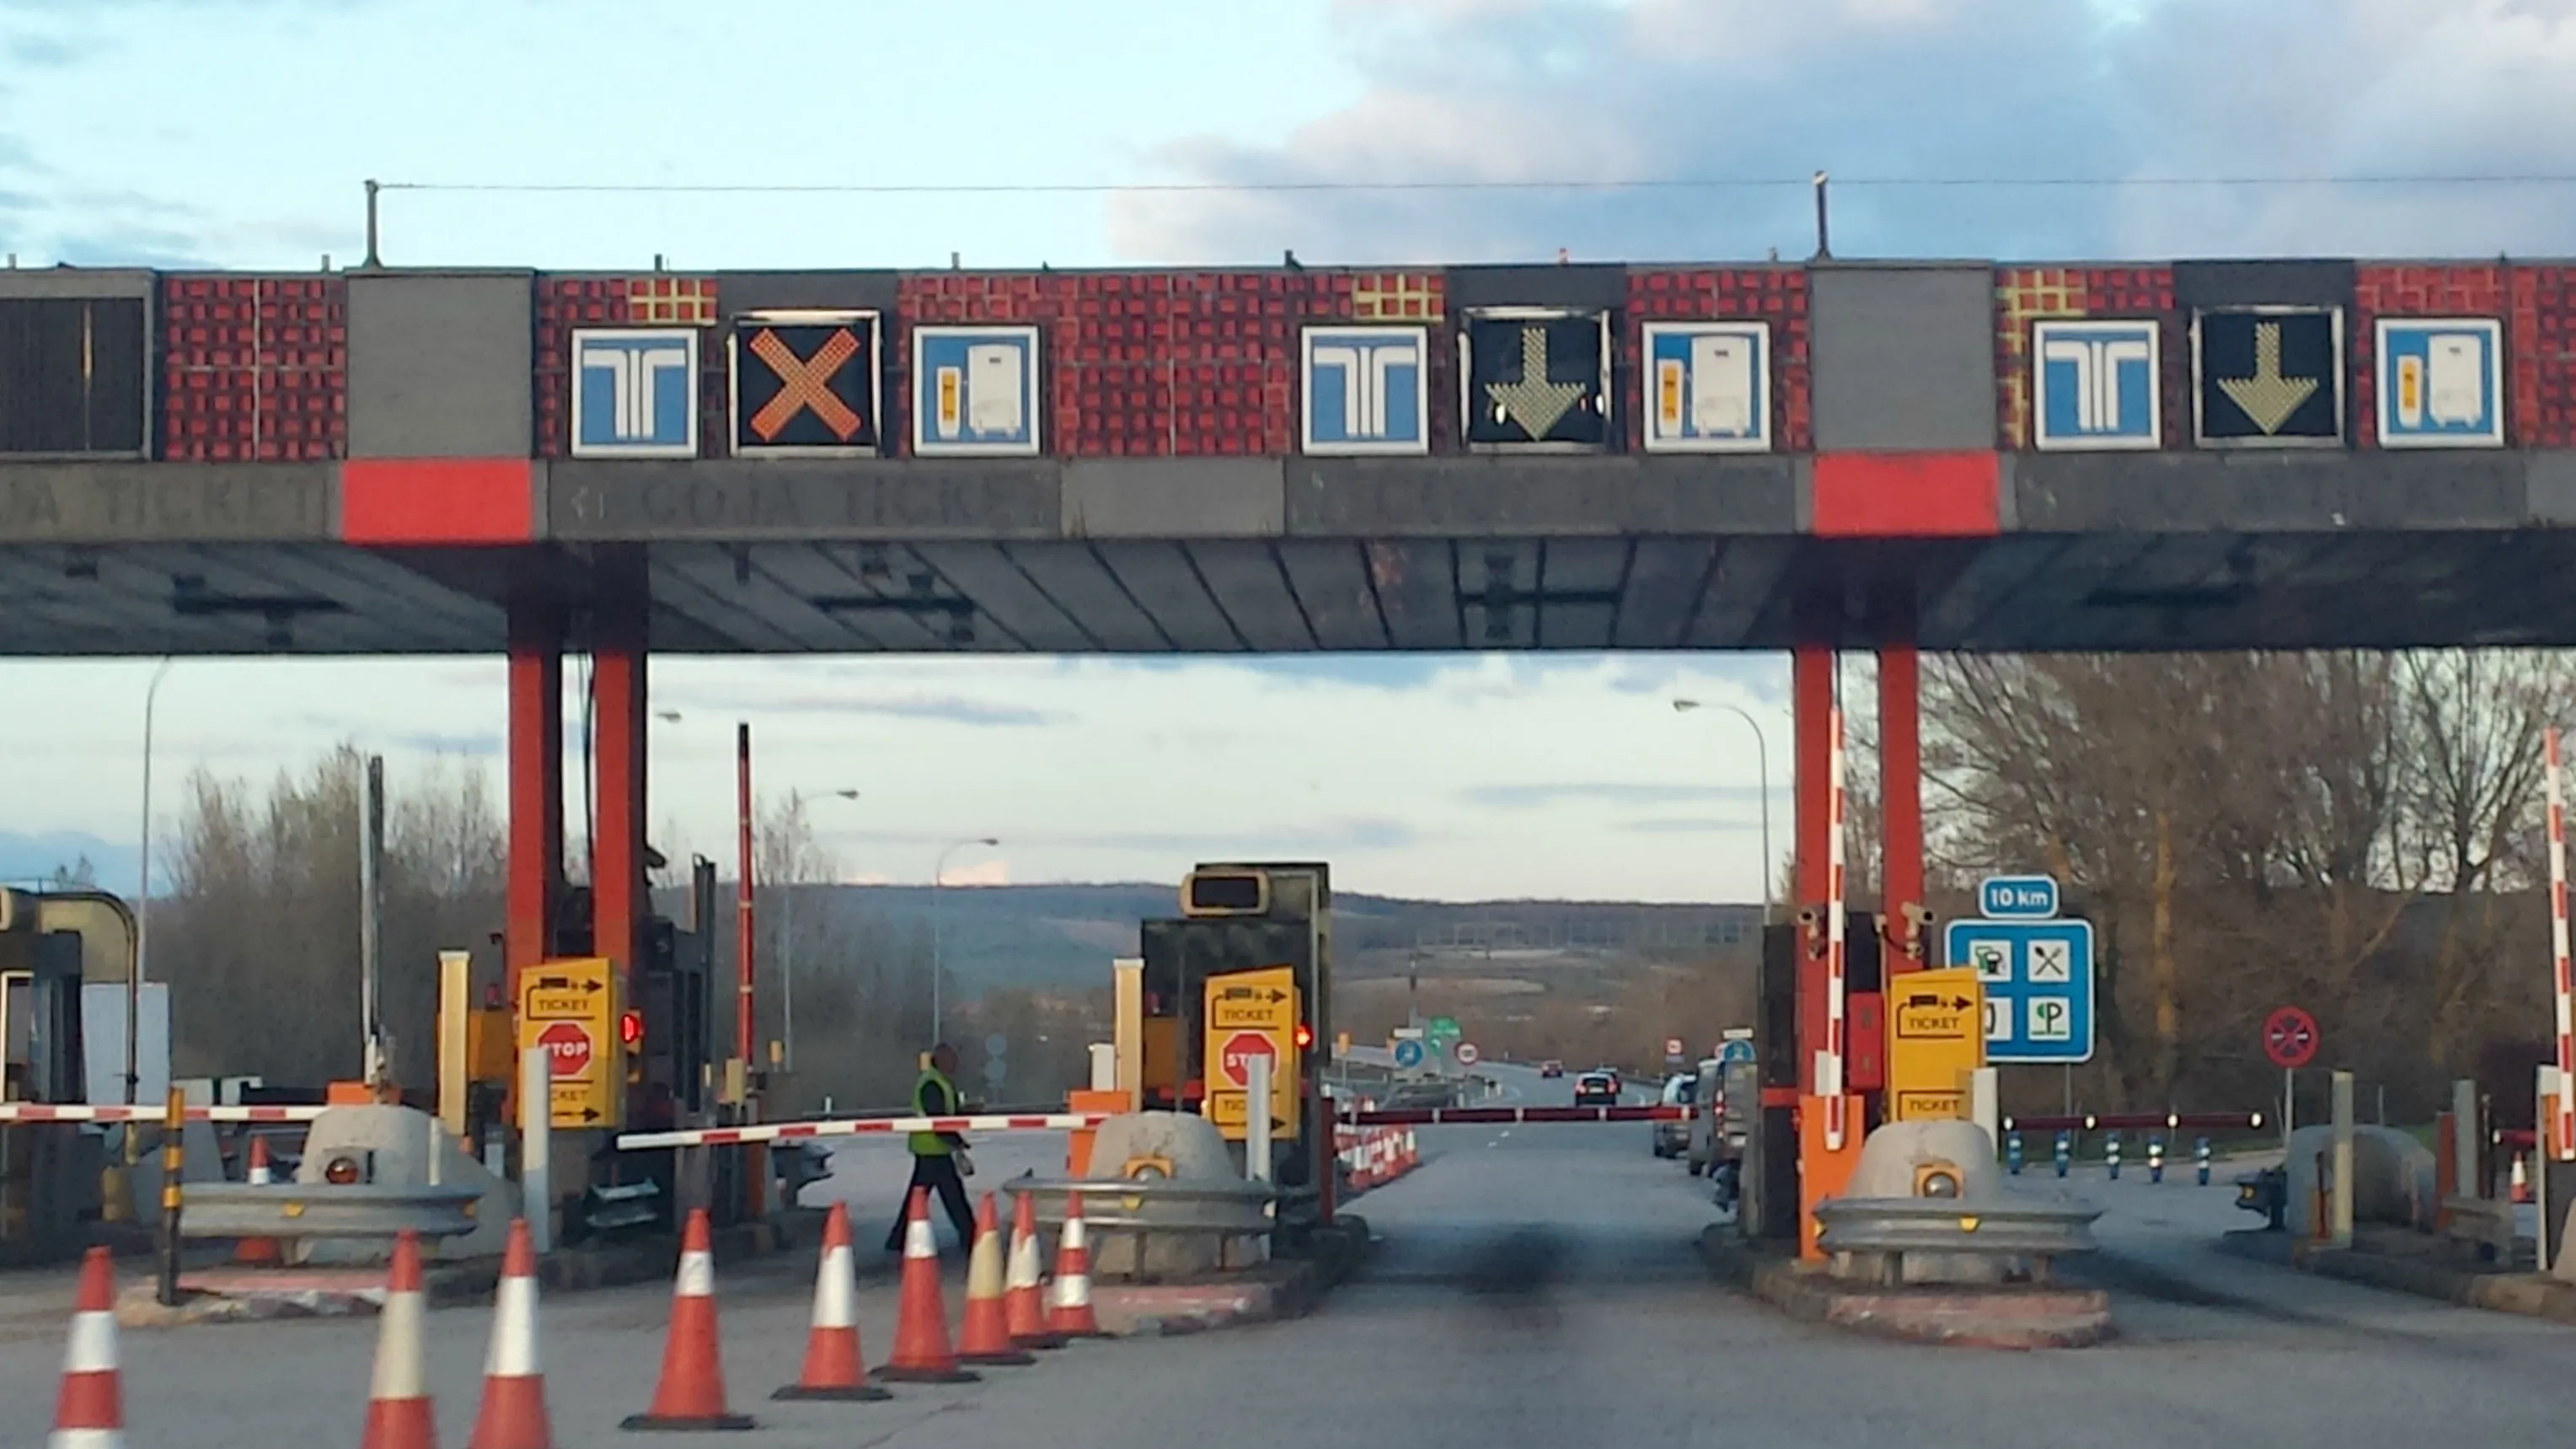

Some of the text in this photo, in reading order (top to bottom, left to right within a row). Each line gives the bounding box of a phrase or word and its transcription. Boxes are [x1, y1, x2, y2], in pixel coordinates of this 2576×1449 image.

[1990, 888, 2048, 907] 10 km
[538, 999, 589, 1011] TICKET
[1224, 1009, 1273, 1021] TICKET
[1908, 1017, 1960, 1029] TICKET
[1909, 1099, 1960, 1112] TICKET
